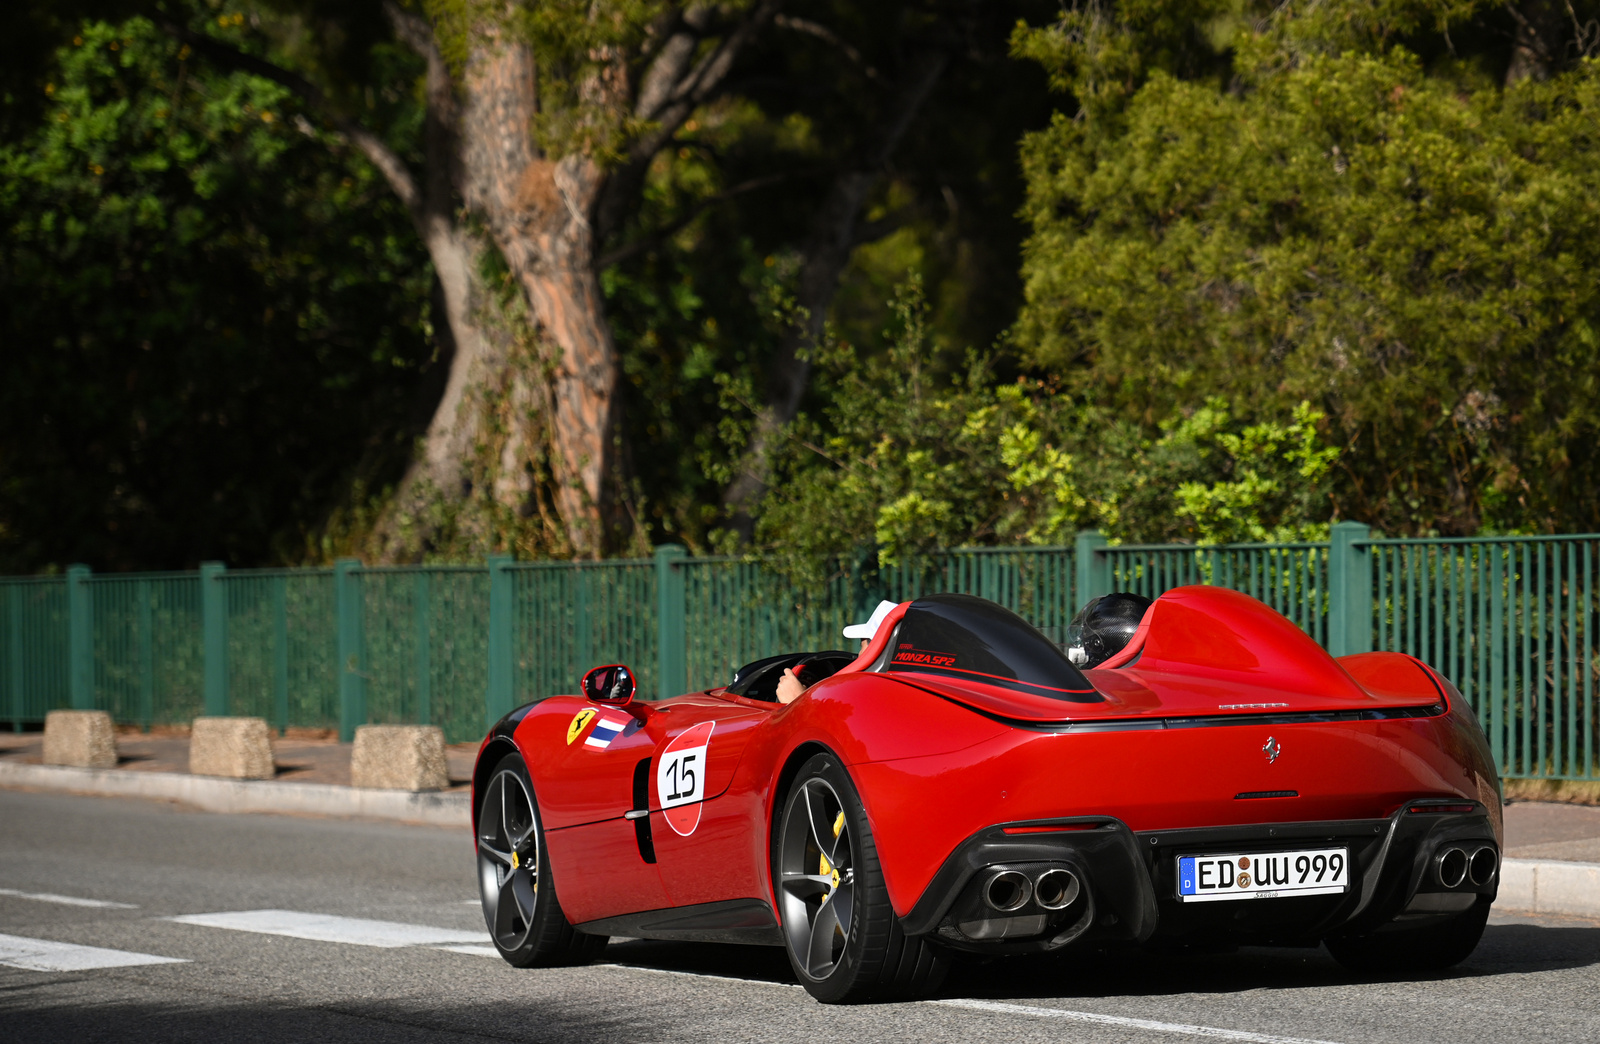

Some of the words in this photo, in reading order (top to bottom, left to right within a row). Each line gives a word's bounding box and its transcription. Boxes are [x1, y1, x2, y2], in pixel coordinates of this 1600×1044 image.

[895, 652, 931, 663] MONZA
[930, 655, 956, 666] SP2
[666, 755, 696, 801] 15
[1198, 860, 1235, 889] ED
[1254, 857, 1289, 886] UU
[1295, 854, 1344, 884] 999
[1184, 879, 1191, 889] D
